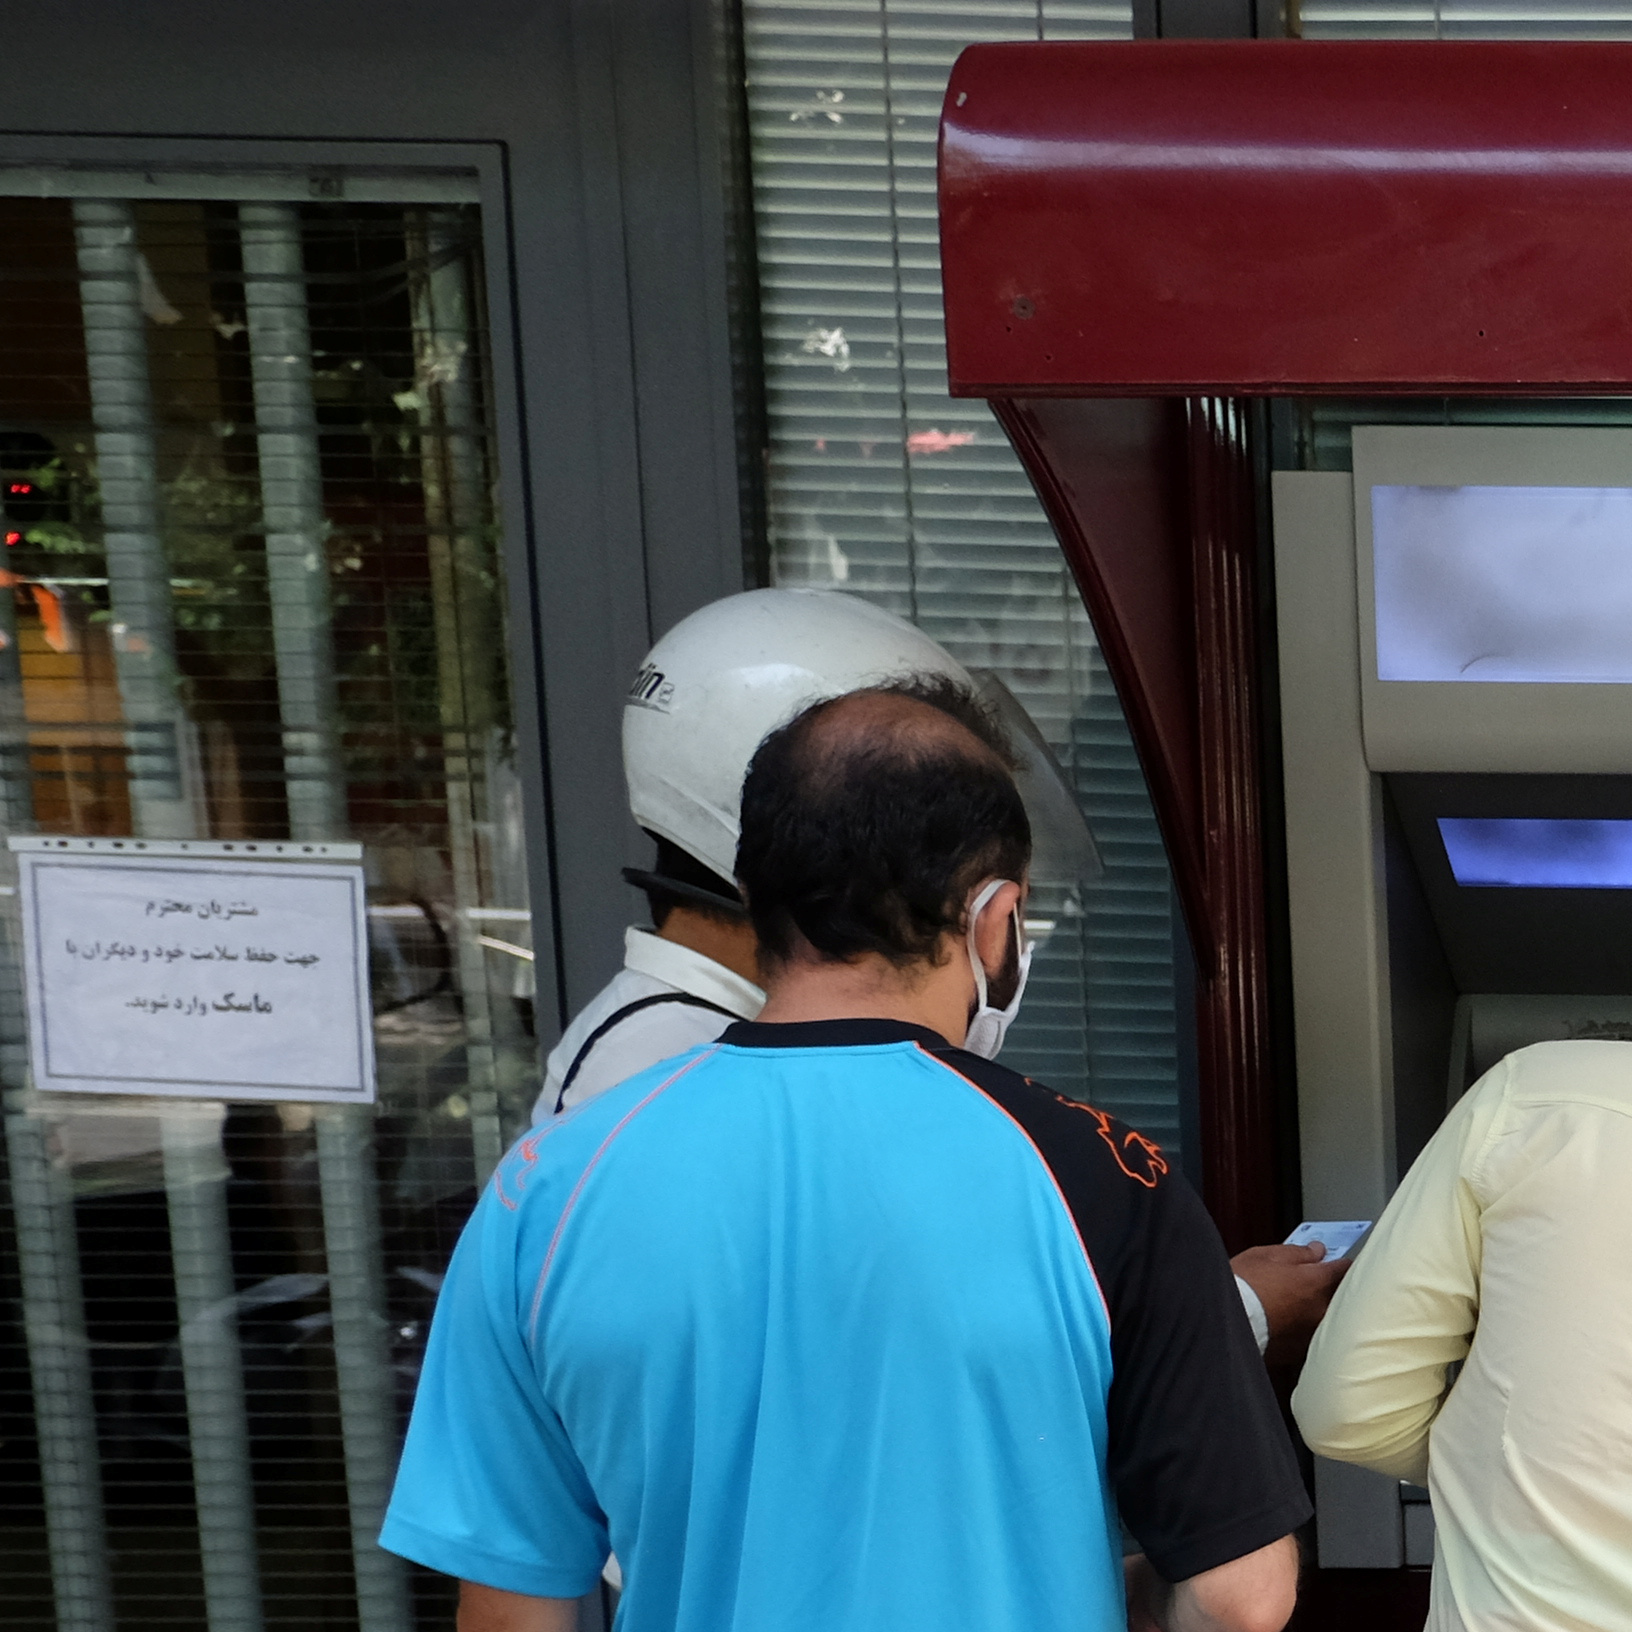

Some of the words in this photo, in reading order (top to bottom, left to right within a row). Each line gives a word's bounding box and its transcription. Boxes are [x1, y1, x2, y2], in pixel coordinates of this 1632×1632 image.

[145, 899, 193, 918] محترم
[197, 899, 259, 921] مشتریان
[65, 938, 79, 957] با
[81, 942, 137, 961] دیگران
[141, 949, 150, 963] و
[154, 946, 185, 964] خود
[190, 945, 239, 962] سلامت
[244, 947, 279, 964] حفظ
[283, 954, 320, 969] جهت
[173, 995, 208, 1017] وارد
[211, 992, 273, 1014] ماسک
